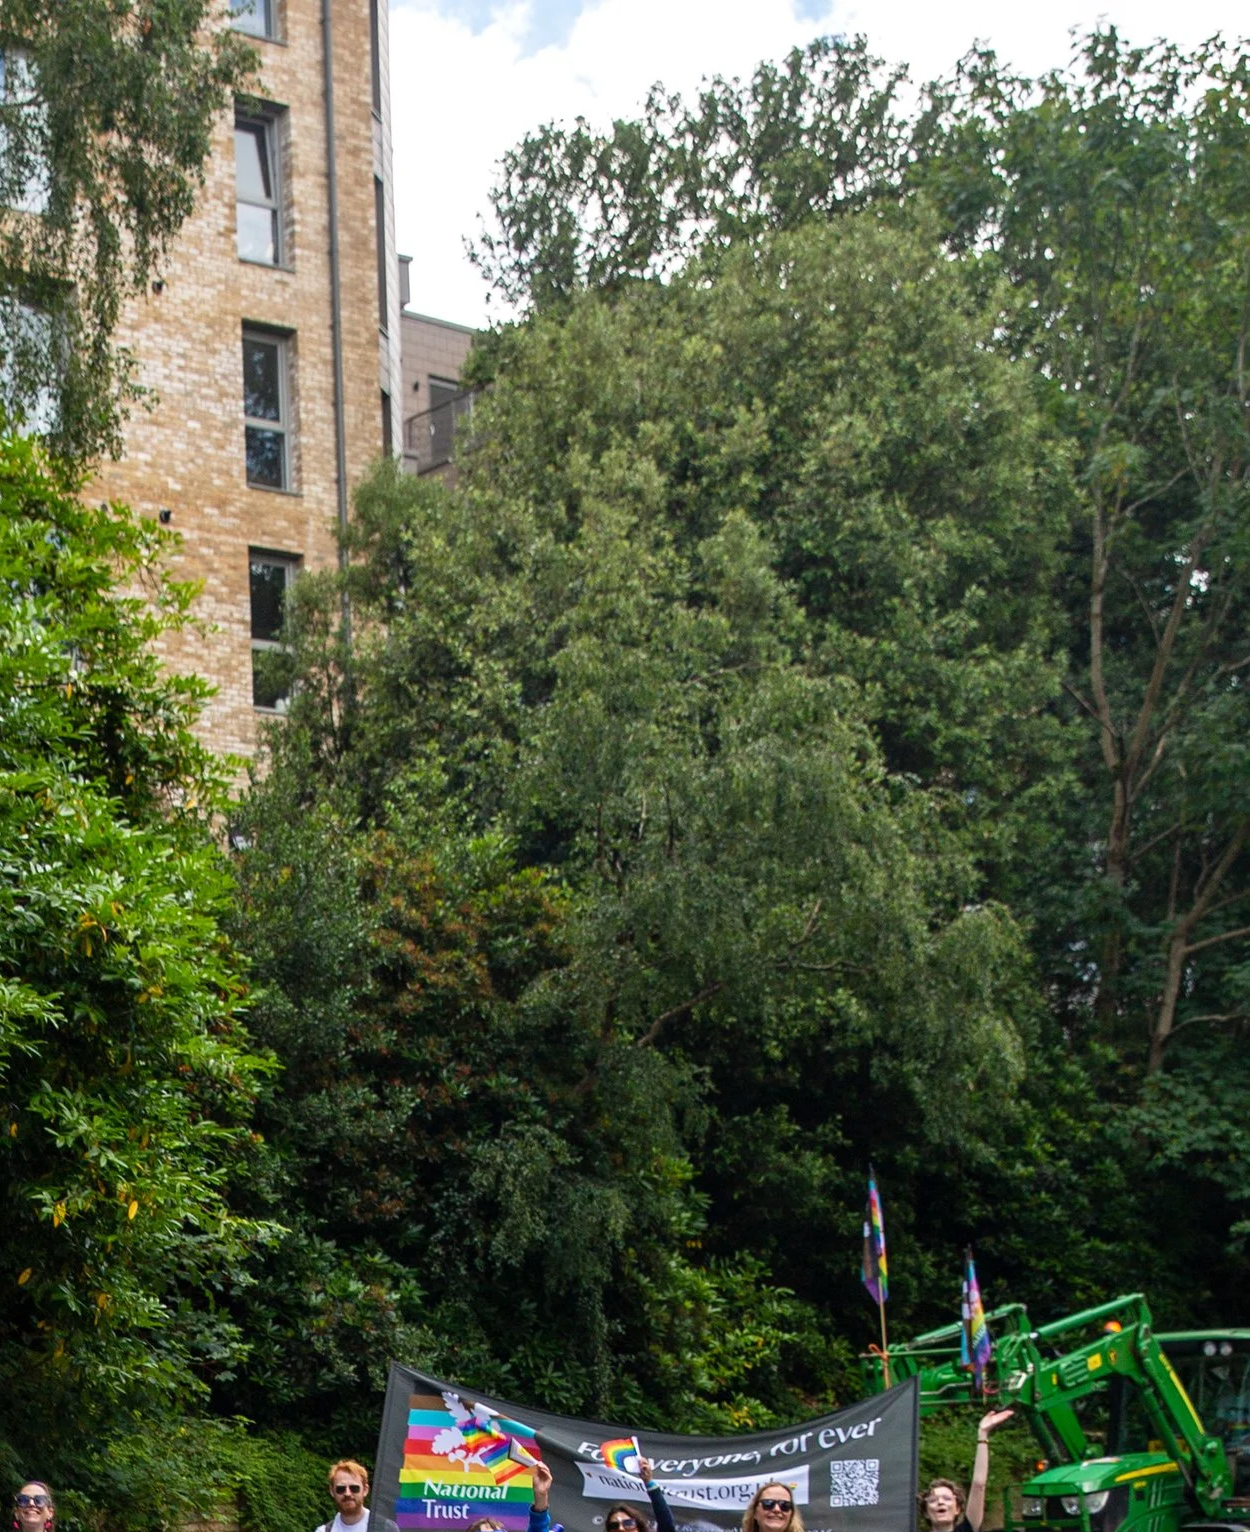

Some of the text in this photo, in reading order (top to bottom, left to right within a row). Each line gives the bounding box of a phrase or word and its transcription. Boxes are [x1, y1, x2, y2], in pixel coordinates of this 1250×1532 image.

[577, 1441, 605, 1461] Fo
[648, 1450, 761, 1477] veryone,
[818, 1417, 882, 1449] ever
[423, 1480, 509, 1499] National
[422, 1499, 470, 1519] Trust
